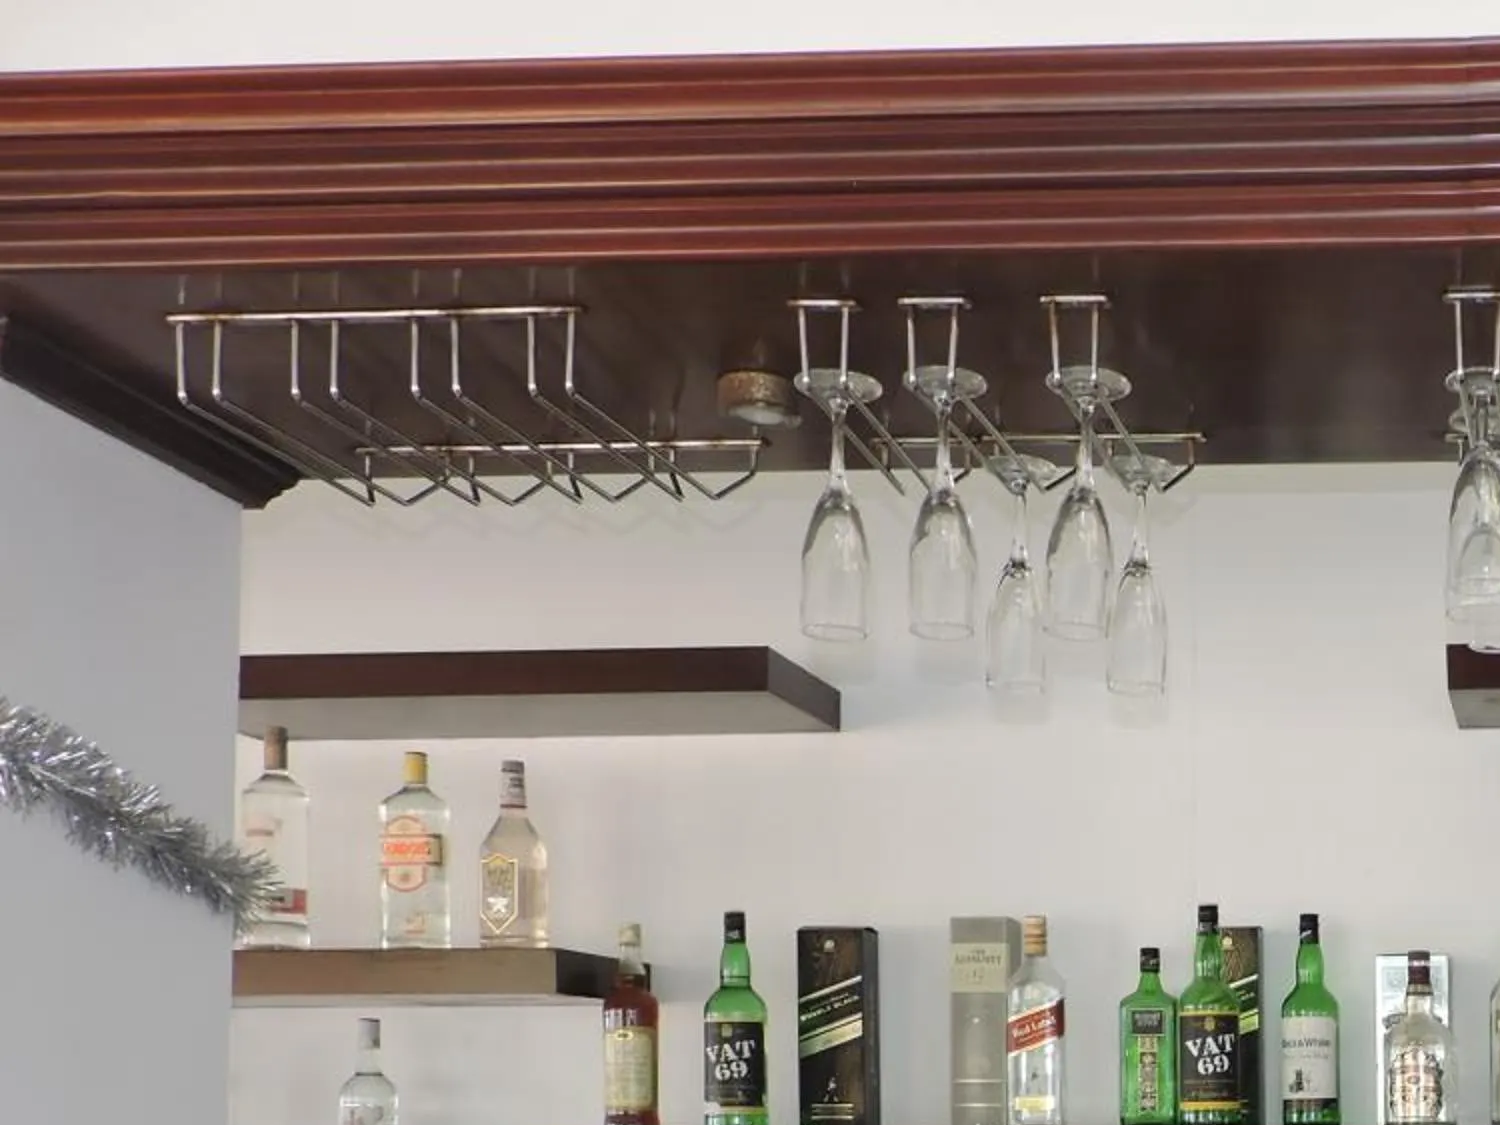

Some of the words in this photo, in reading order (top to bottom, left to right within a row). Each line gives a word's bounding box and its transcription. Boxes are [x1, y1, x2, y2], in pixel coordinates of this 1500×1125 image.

[706, 1039, 756, 1063] VAT
[1185, 1033, 1235, 1058] VAT
[715, 1060, 749, 1081] 69
[1197, 1054, 1230, 1076] 69
